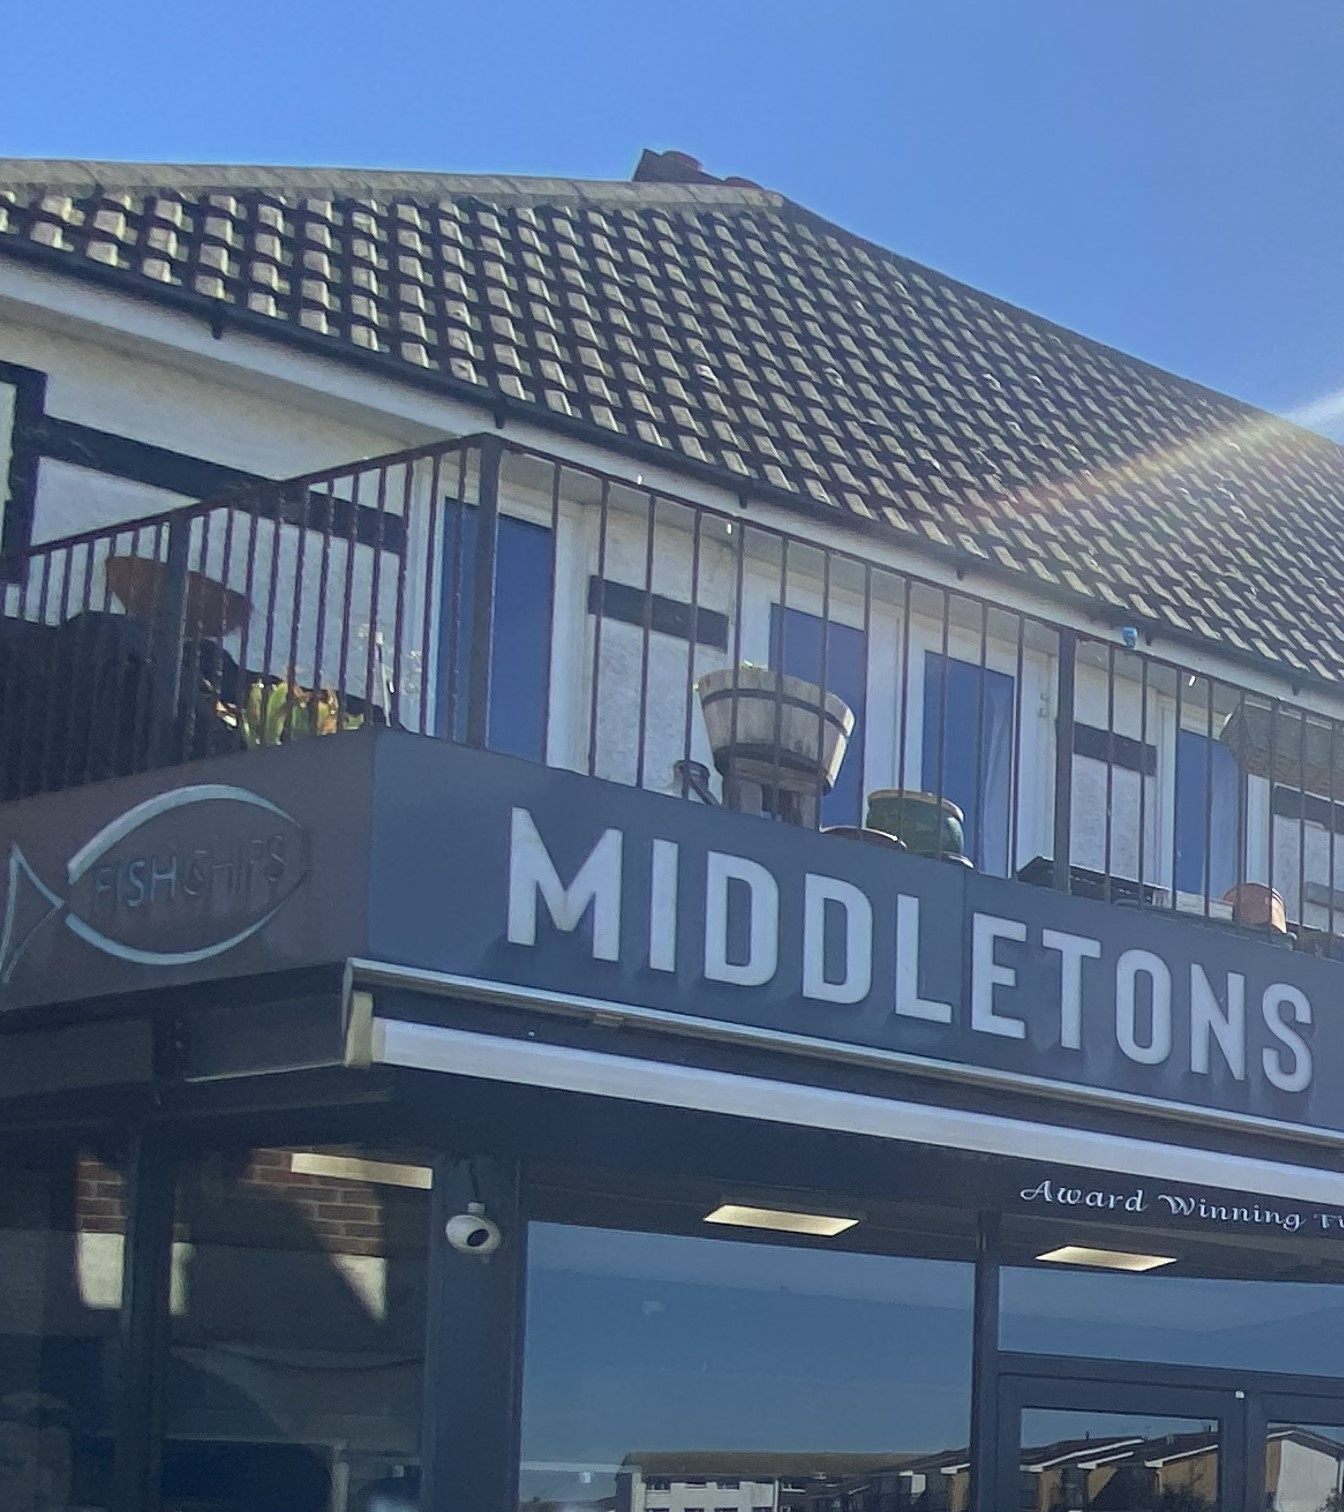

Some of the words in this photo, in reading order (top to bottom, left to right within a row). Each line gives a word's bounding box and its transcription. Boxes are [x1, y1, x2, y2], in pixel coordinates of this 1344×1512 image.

[94, 855, 177, 908] FISH
[507, 804, 1314, 1094] MIDDLETONS
[1020, 1179, 1149, 1213] Award
[1157, 1194, 1306, 1232] Winning
